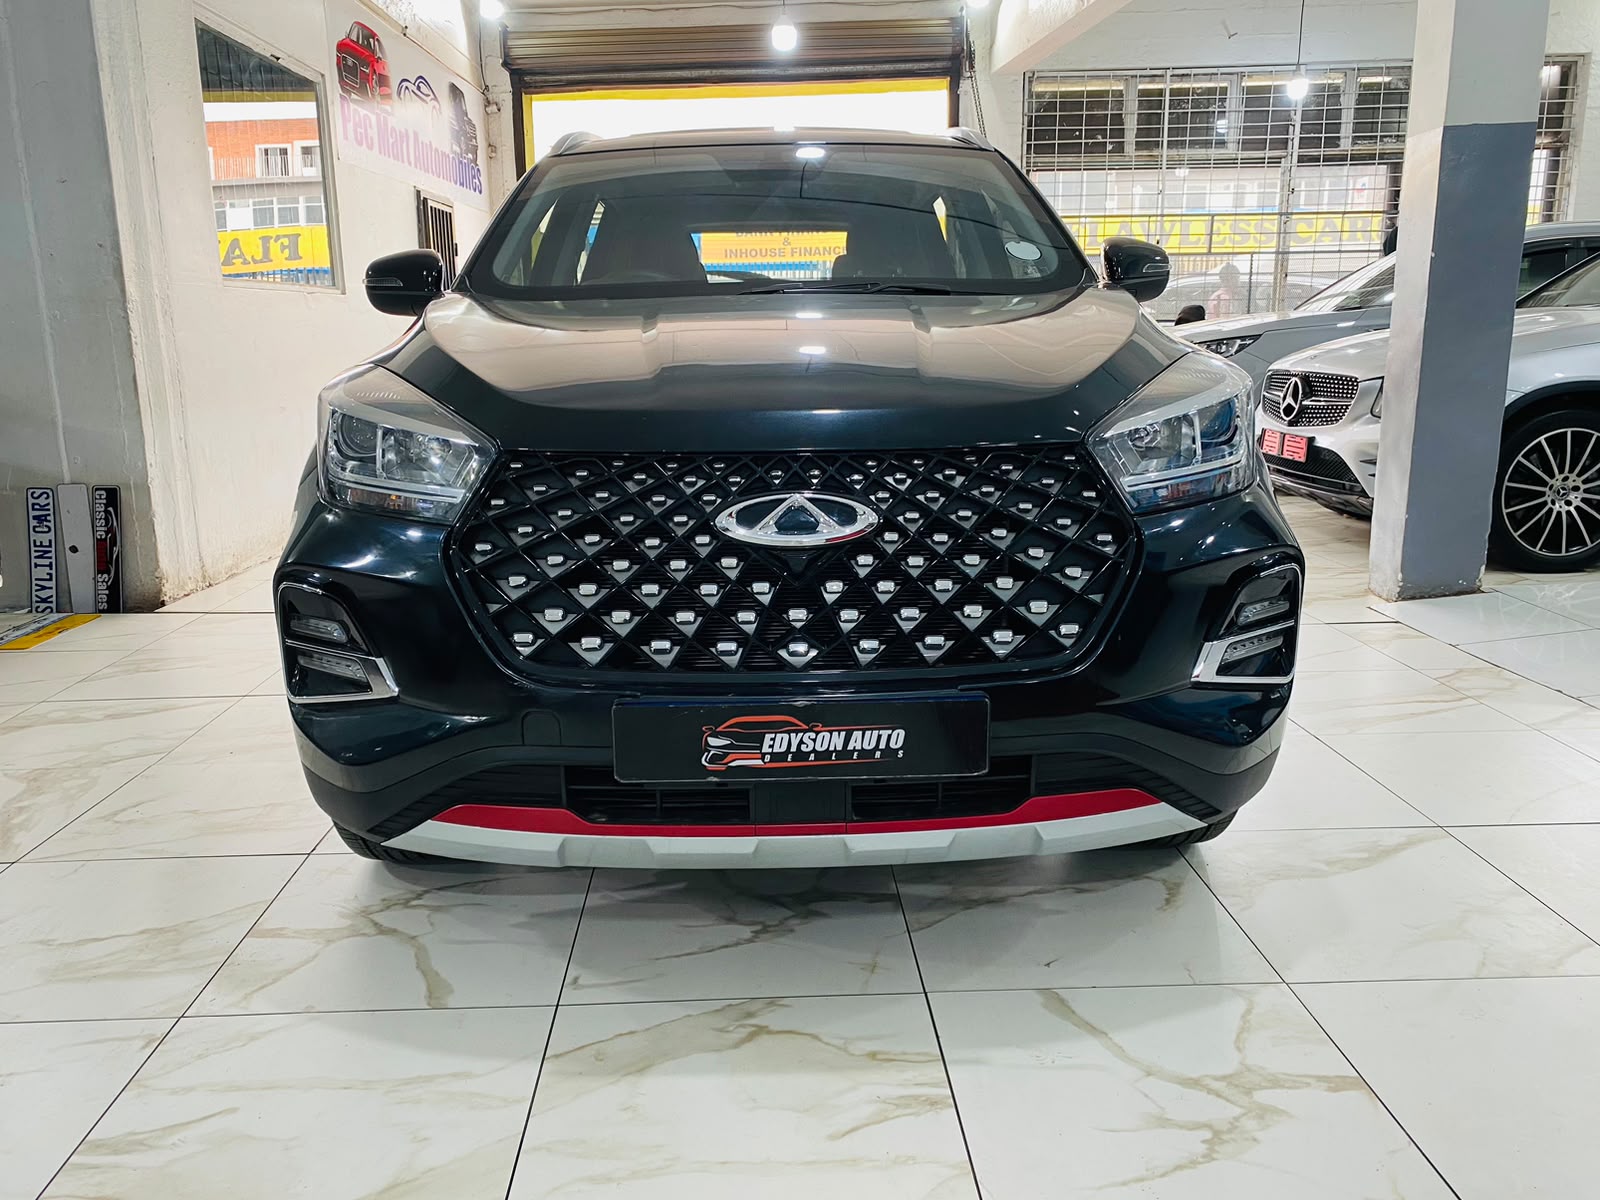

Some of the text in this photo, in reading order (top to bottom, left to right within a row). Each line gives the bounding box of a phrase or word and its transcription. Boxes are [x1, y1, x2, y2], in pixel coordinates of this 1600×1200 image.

[339, 93, 483, 195] Pec Mart Automobiles
[782, 237, 792, 247] &
[1287, 217, 1382, 244] CAR
[724, 247, 786, 259] INHOUSE
[31, 490, 52, 534] CARS
[95, 490, 108, 539] Classic
[32, 538, 54, 613] SKYLINE
[97, 573, 109, 610] Sales
[761, 729, 906, 753] EDYSON AUTO
[763, 750, 905, 763] DEALERS
